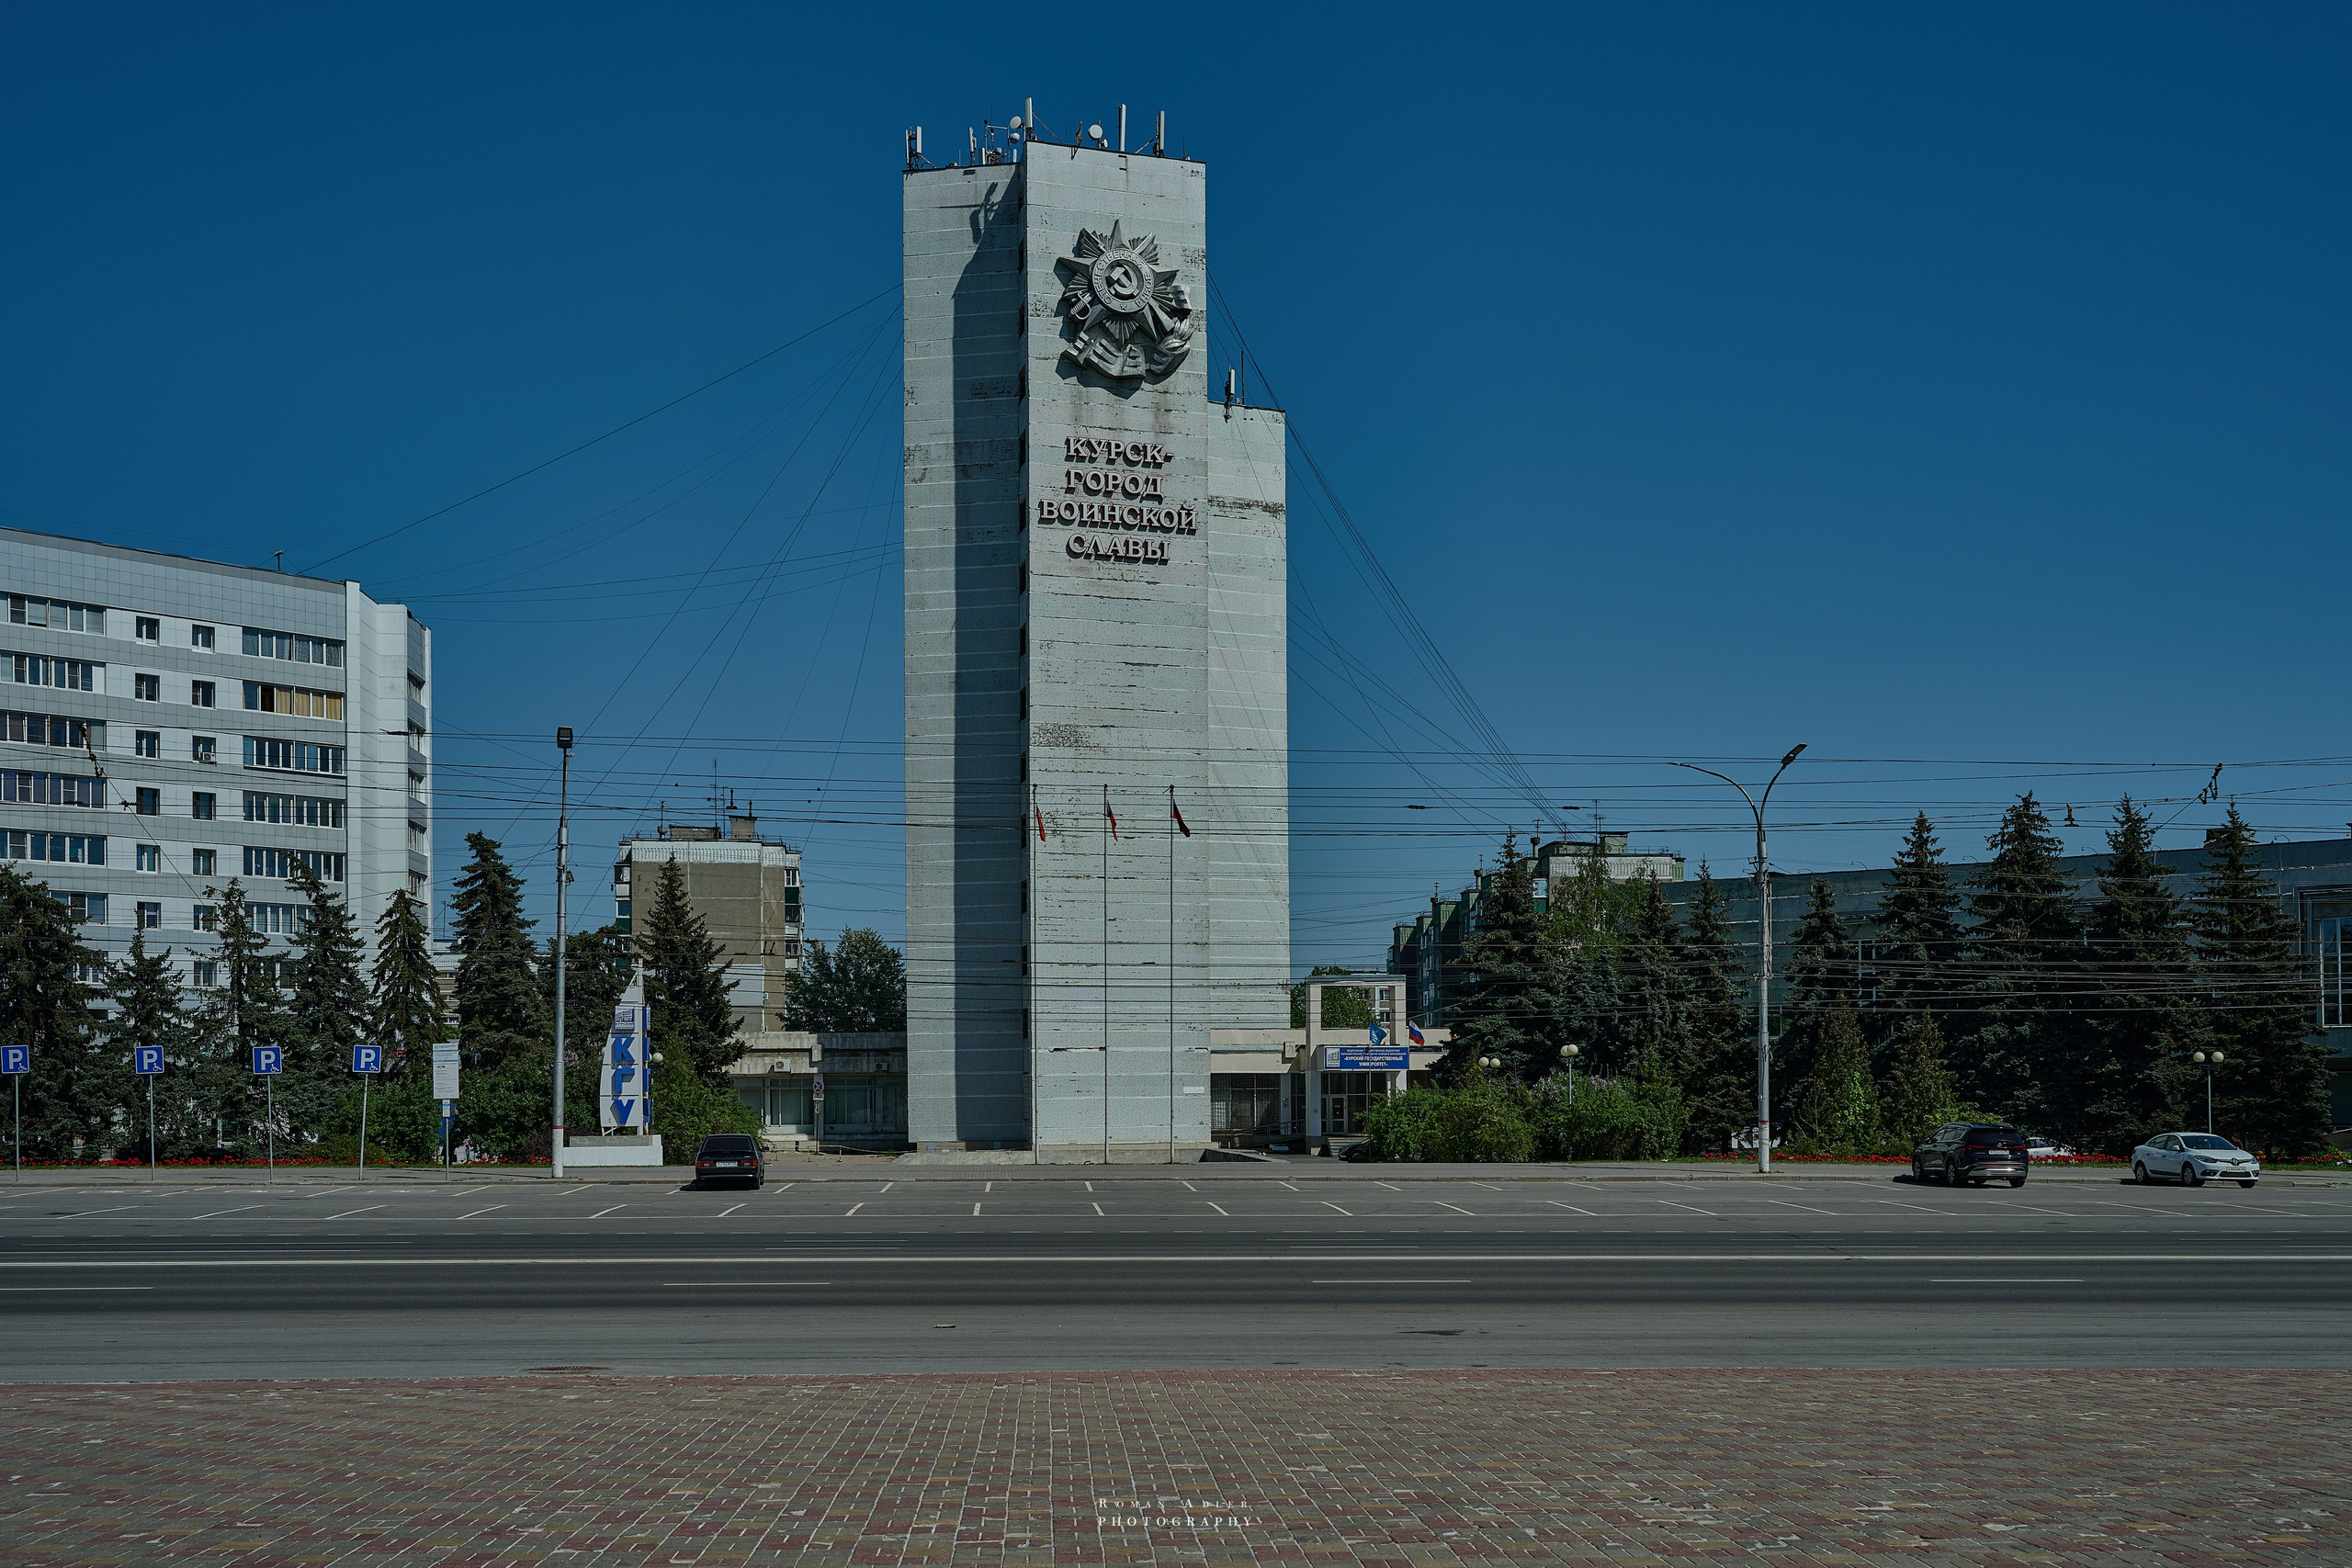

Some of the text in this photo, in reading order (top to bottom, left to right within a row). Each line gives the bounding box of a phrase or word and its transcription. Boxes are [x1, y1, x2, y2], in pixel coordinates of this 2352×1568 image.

[1067, 468, 1165, 500] ГОРОД
[1039, 499, 1199, 531] ВОИНСКОЙ
[1068, 533, 1171, 561] СЛАВЫ
[8, 1049, 23, 1069] P
[142, 1050, 158, 1070] P
[260, 1050, 276, 1071] P
[361, 1049, 376, 1069] P
